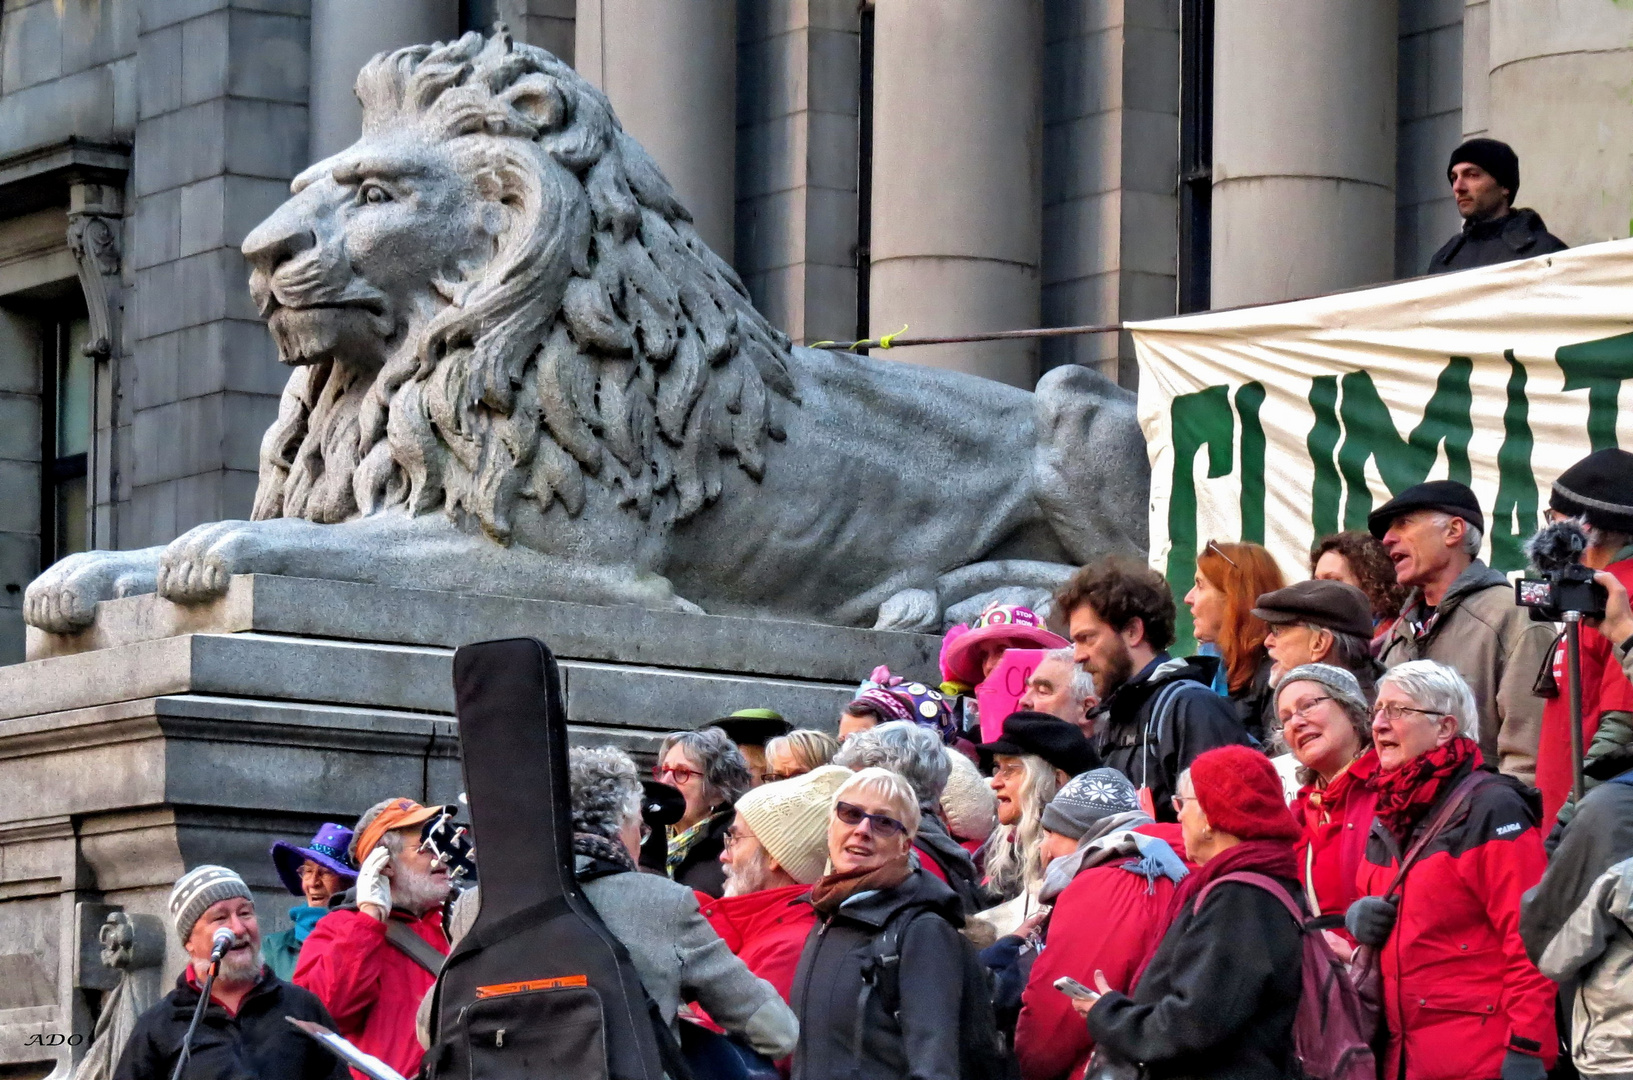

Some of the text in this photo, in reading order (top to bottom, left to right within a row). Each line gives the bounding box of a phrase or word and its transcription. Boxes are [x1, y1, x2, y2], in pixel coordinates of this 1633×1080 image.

[1015, 610, 1033, 619] STOP
[1015, 618, 1033, 627] NOW
[1495, 821, 1522, 836] TAIGA
